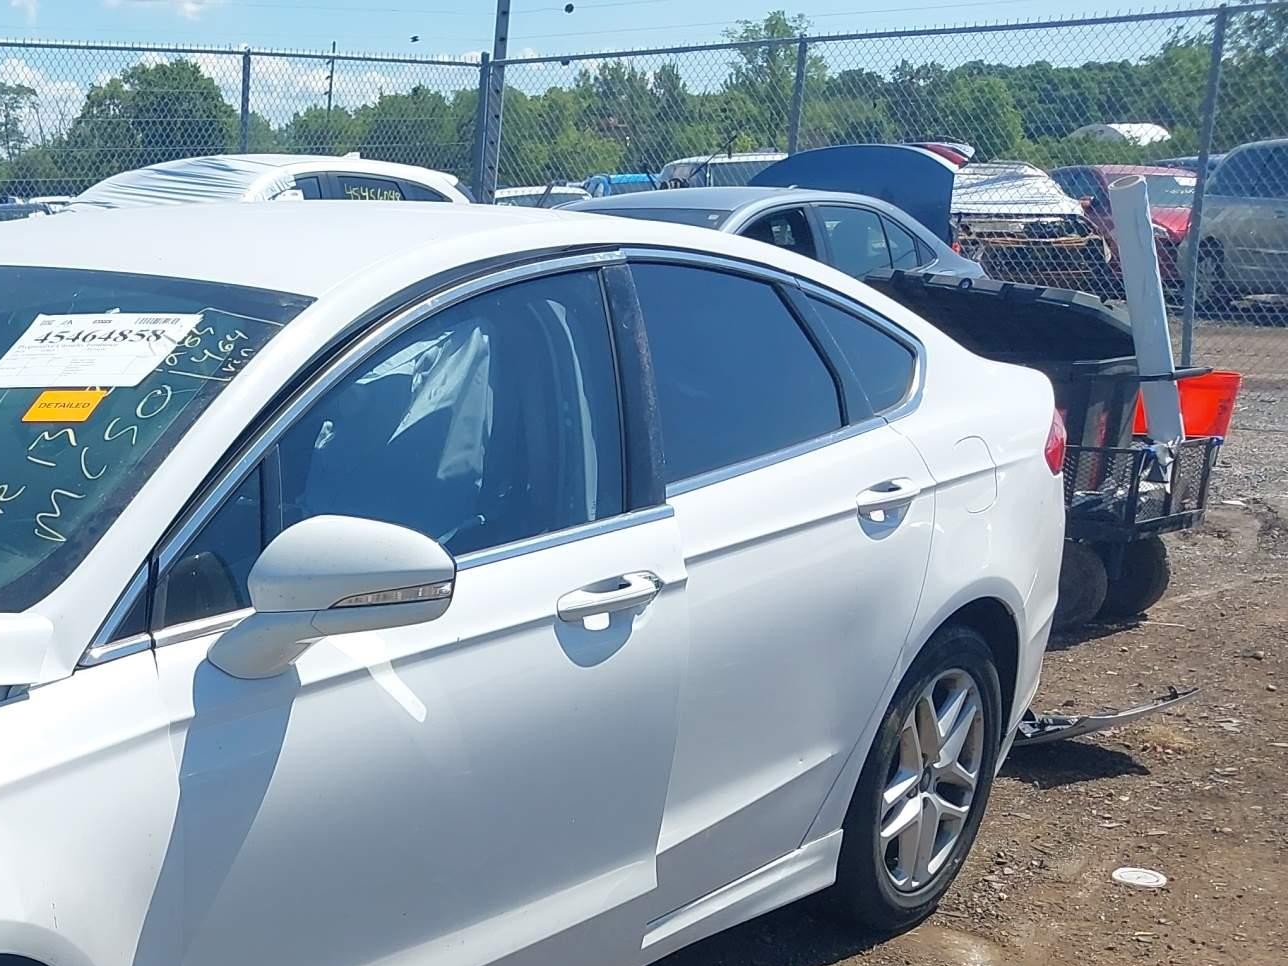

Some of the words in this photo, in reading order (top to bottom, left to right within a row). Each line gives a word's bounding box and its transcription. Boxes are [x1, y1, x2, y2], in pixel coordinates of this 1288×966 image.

[34, 329, 166, 343] 45464858
[37, 402, 91, 410] DETAILED
[26, 427, 78, 467] 13
